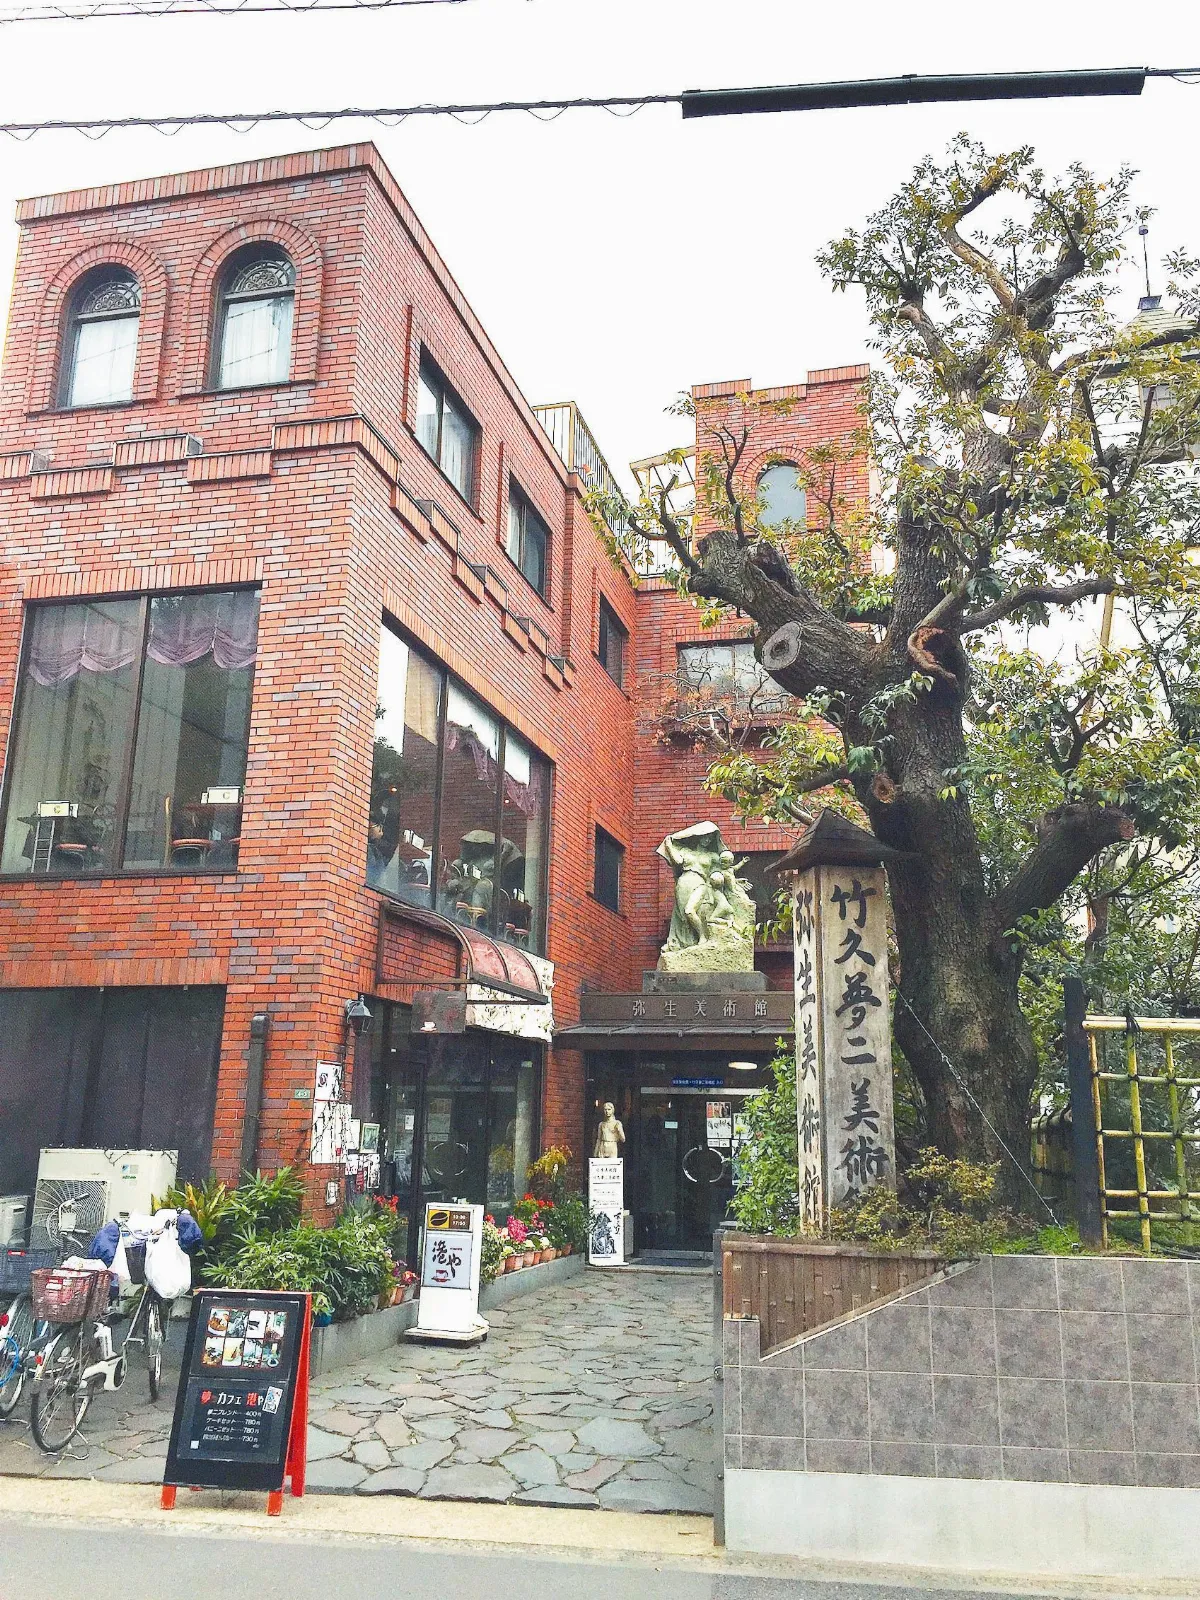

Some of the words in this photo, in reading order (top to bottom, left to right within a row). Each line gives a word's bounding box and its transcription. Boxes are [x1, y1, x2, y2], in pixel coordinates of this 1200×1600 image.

[632, 1000, 768, 1017] 弥生美術館
[795, 890, 821, 1222] 弥生美術館
[830, 879, 889, 1200] 竹久夢二美術
